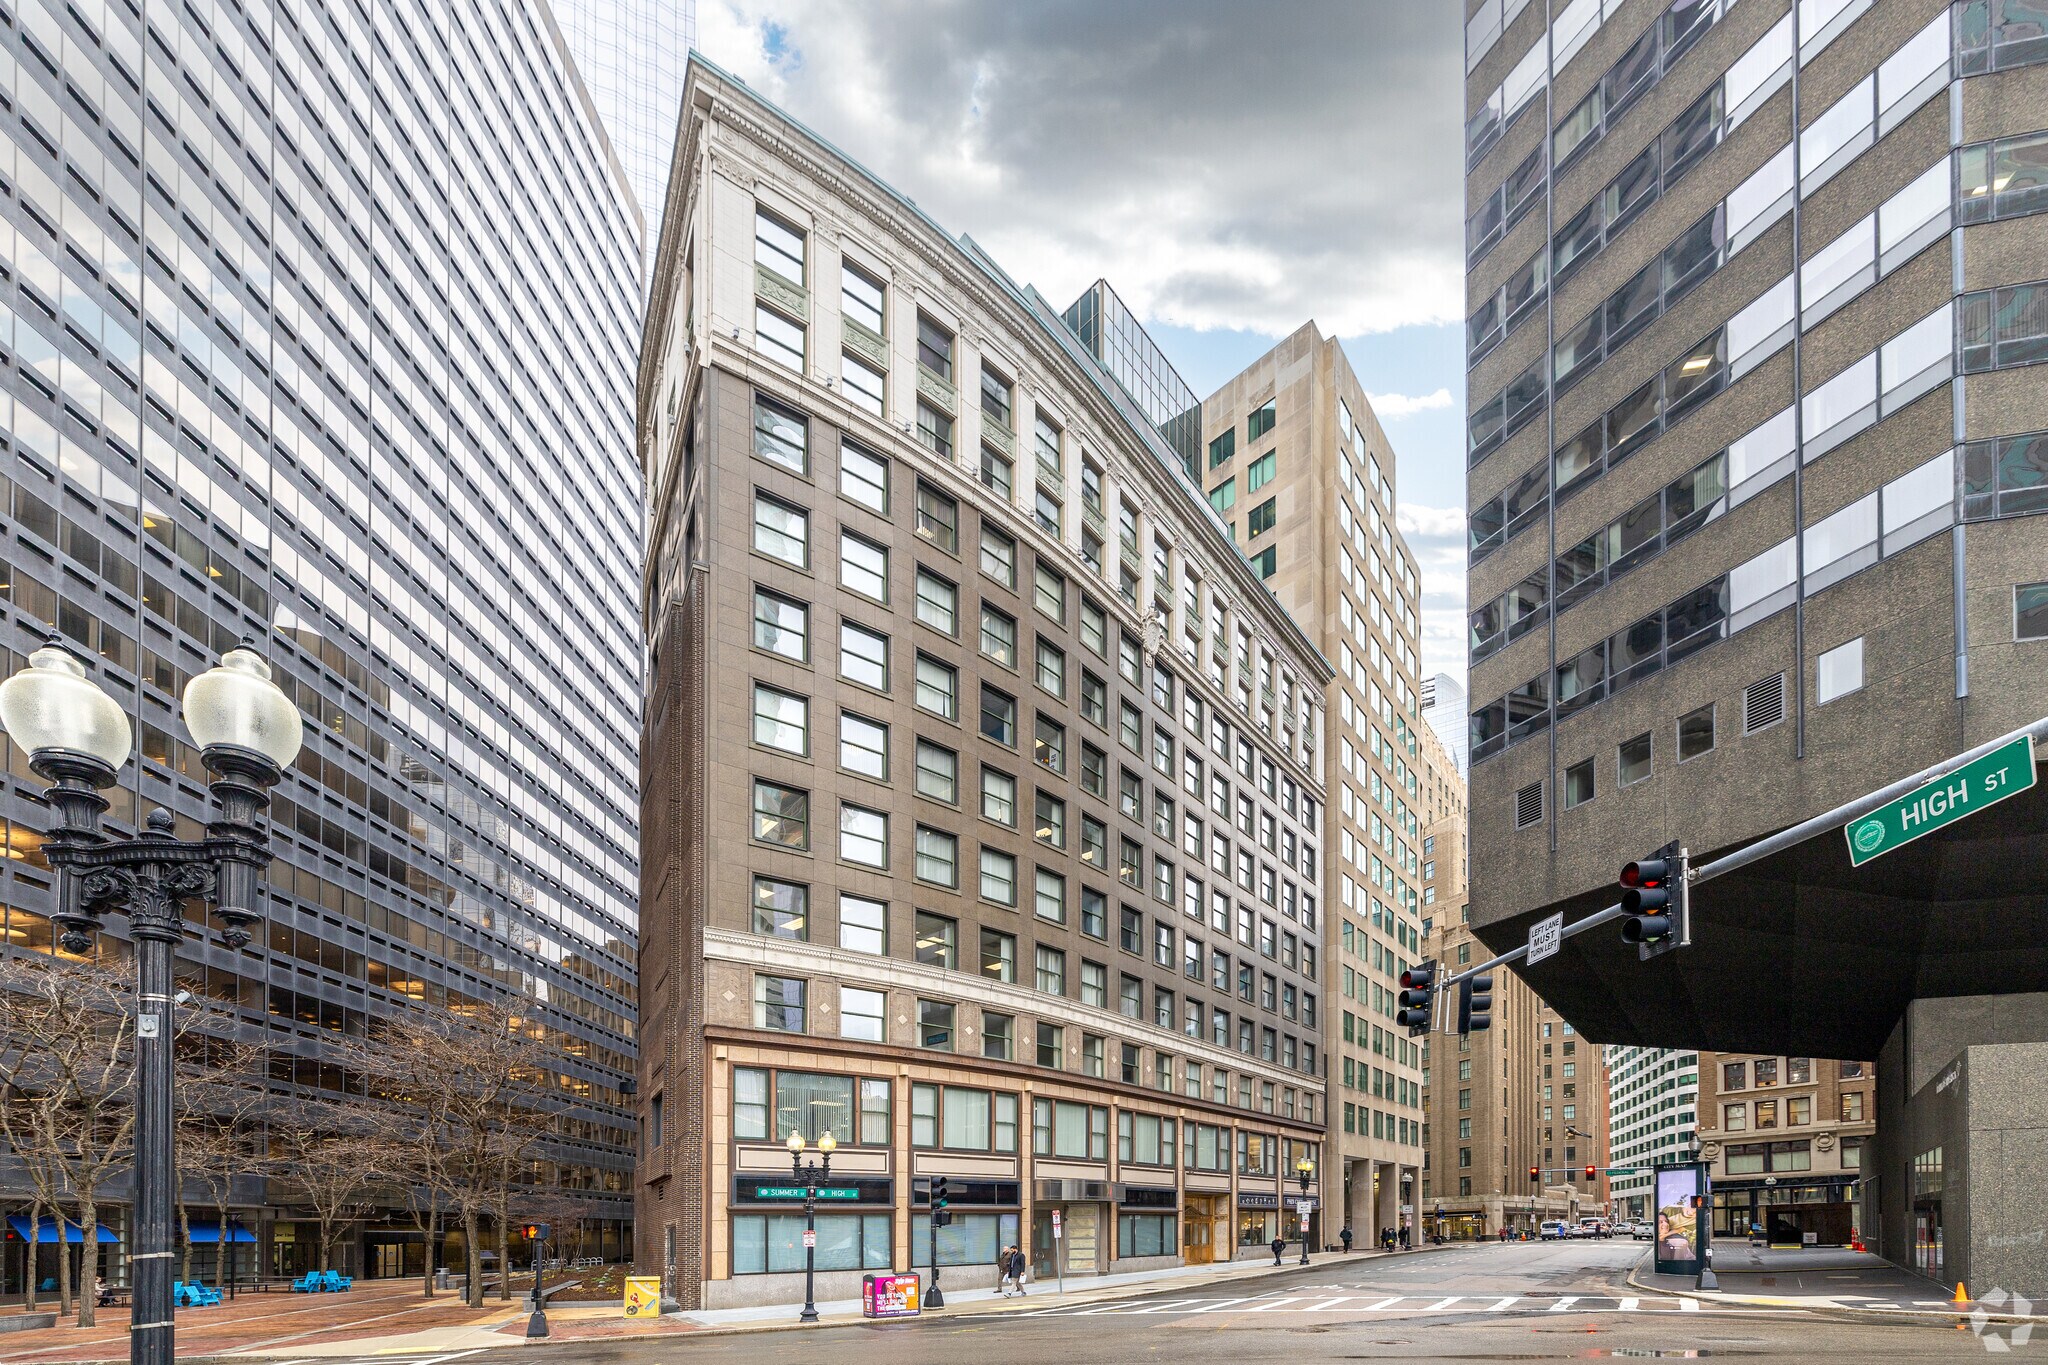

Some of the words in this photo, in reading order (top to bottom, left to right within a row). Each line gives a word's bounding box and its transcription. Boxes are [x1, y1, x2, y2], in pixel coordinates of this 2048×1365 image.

[1901, 778, 1969, 831] HIGH
[1984, 767, 2009, 792] ST
[1532, 926, 1544, 938] LEFT
[1545, 918, 1559, 931] LANE
[1534, 930, 1555, 947] MUST
[1531, 947, 1543, 958] TURN
[1545, 939, 1557, 951] LEFT
